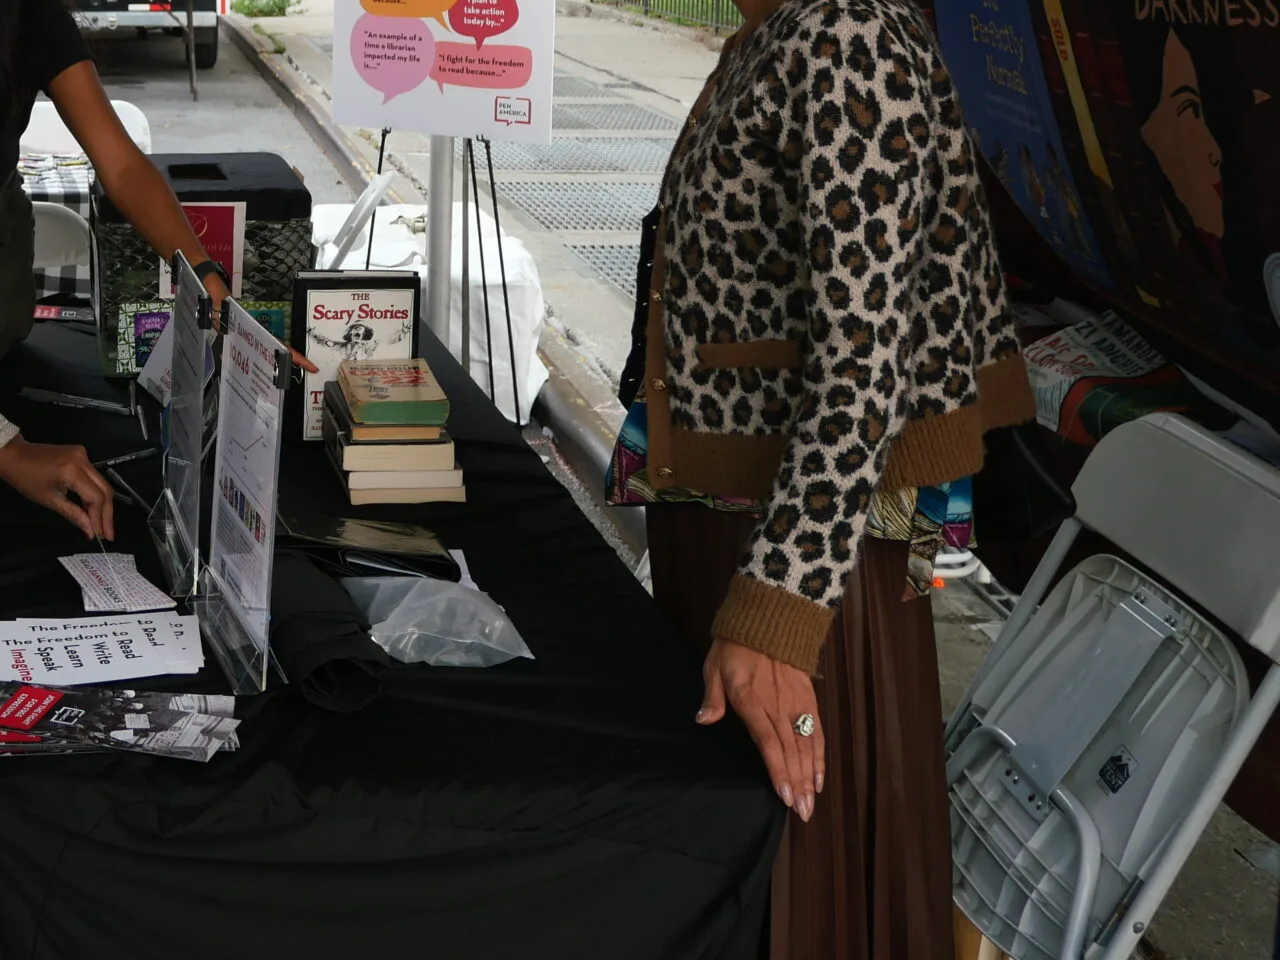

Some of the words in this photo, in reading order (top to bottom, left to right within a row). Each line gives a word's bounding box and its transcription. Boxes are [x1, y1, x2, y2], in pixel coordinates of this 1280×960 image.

[464, 6, 480, 14] take
[464, 18, 484, 26] today
[379, 33, 407, 41] example
[1051, 17, 1069, 62] SOLD
[387, 43, 415, 51] librarian
[364, 52, 395, 62] impacted
[447, 54, 463, 64] fight
[465, 56, 476, 64] for
[478, 57, 490, 65] the
[492, 58, 524, 67] freedom
[448, 66, 464, 74] read
[499, 109, 526, 117] AMERICA
[351, 293, 370, 301] THE
[313, 304, 355, 325] Scary
[358, 303, 409, 320] Stories
[103, 585, 124, 604] BOOKS
[137, 619, 154, 627] to
[37, 633, 108, 644] Freedom
[111, 630, 129, 638] to
[90, 641, 114, 666] Write
[116, 638, 144, 660] Read
[36, 646, 64, 672] Speak
[63, 643, 85, 669] Learn
[9, 648, 34, 683] Imagine
[0, 693, 29, 719] EXPRESSION
